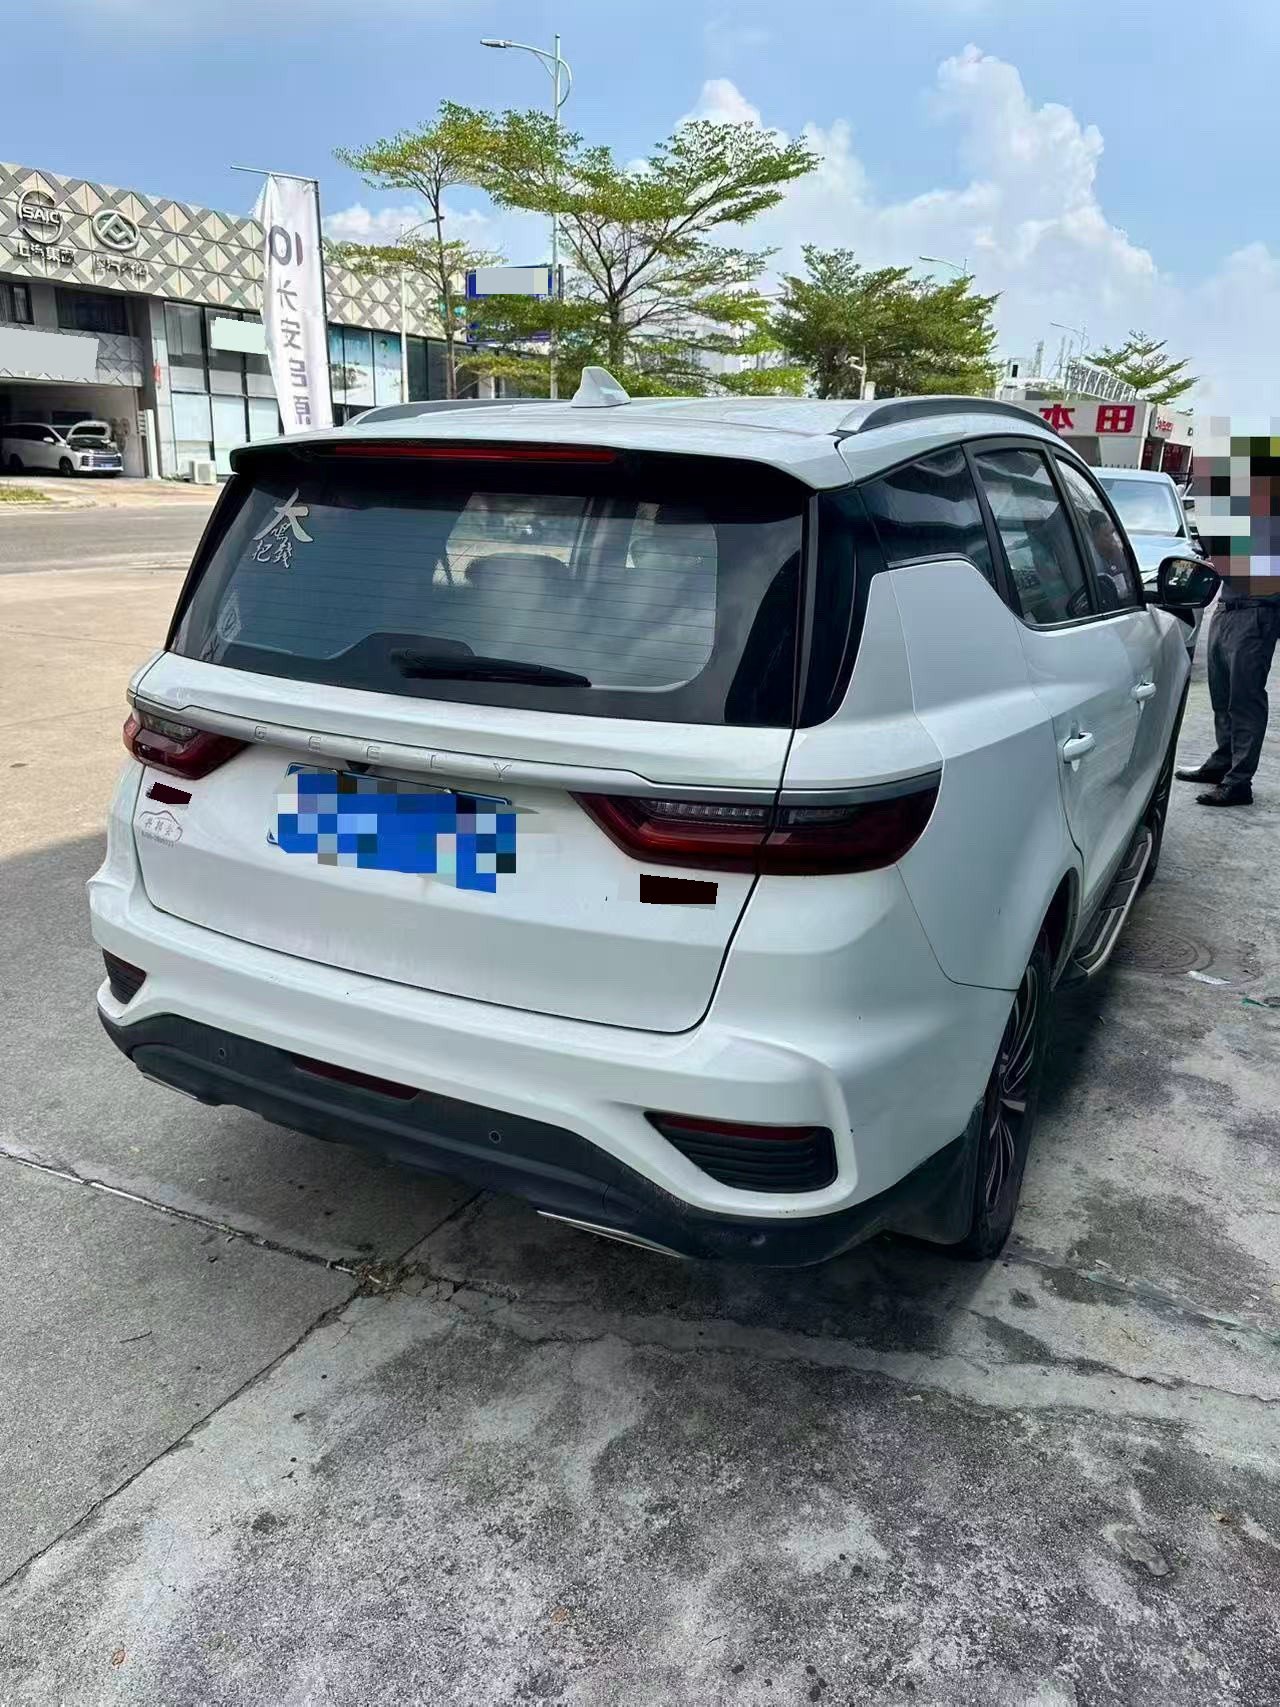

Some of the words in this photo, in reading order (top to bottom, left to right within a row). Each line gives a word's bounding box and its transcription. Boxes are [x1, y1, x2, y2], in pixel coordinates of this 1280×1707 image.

[22, 206, 60, 224] SAIC
[1039, 403, 1136, 433] 本田
[254, 725, 513, 783] GEELY
